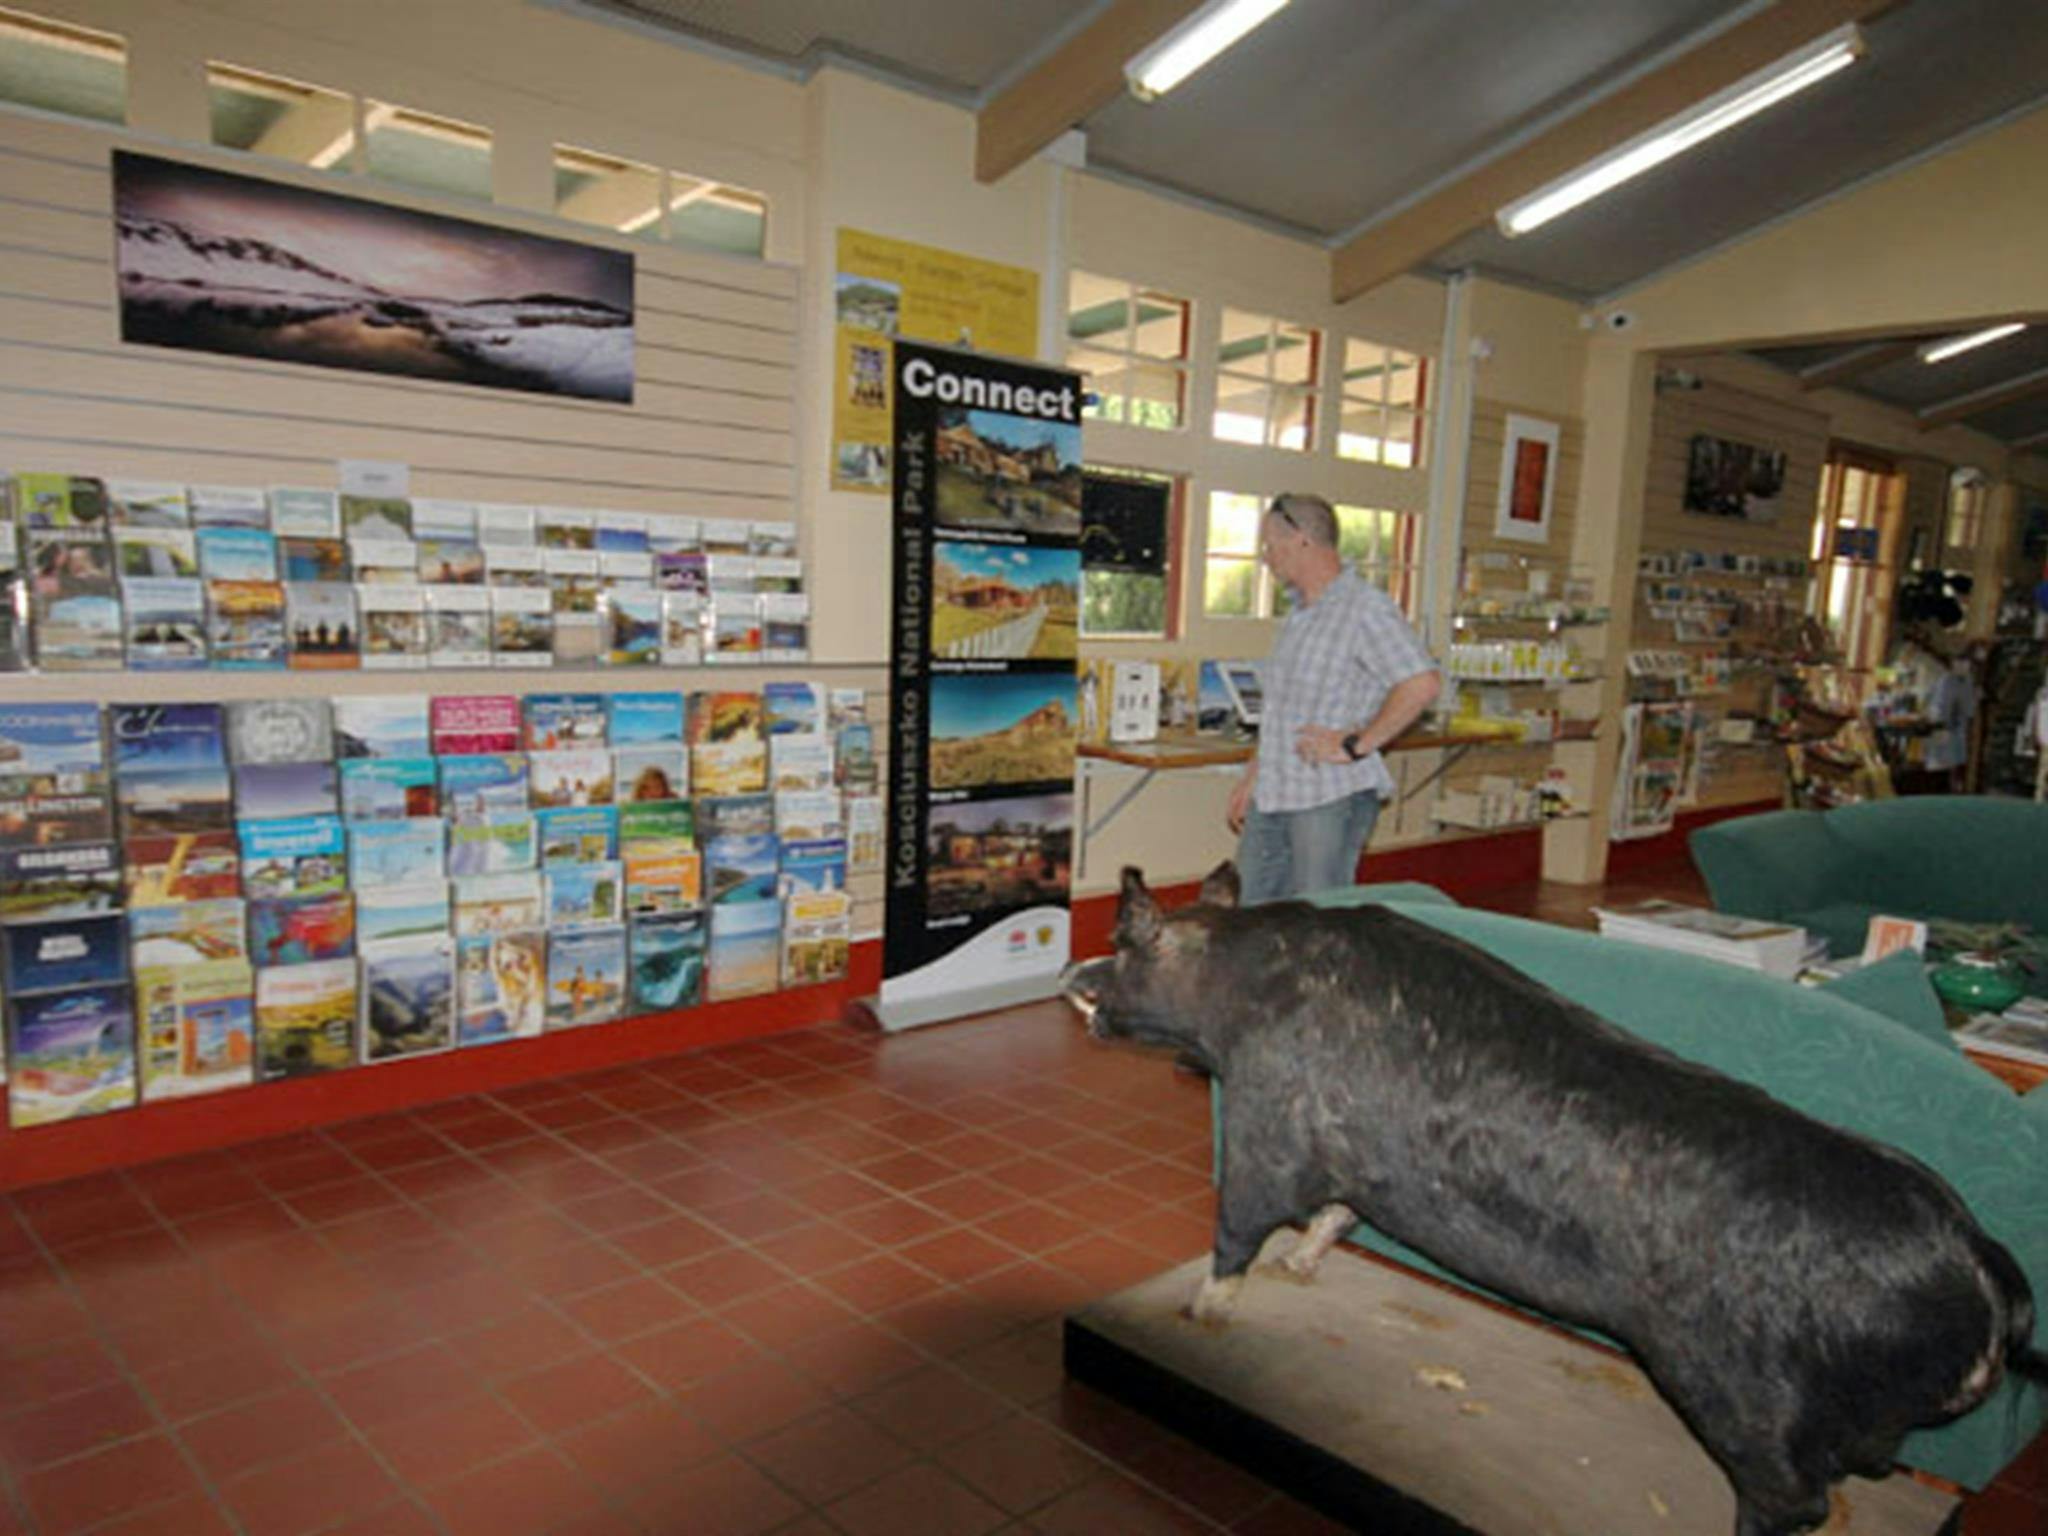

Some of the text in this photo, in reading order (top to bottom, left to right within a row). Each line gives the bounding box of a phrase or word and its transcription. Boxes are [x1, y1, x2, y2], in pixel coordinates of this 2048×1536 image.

[902, 358, 1075, 420] Connect
[895, 431, 926, 888] Kosciuszko National Park
